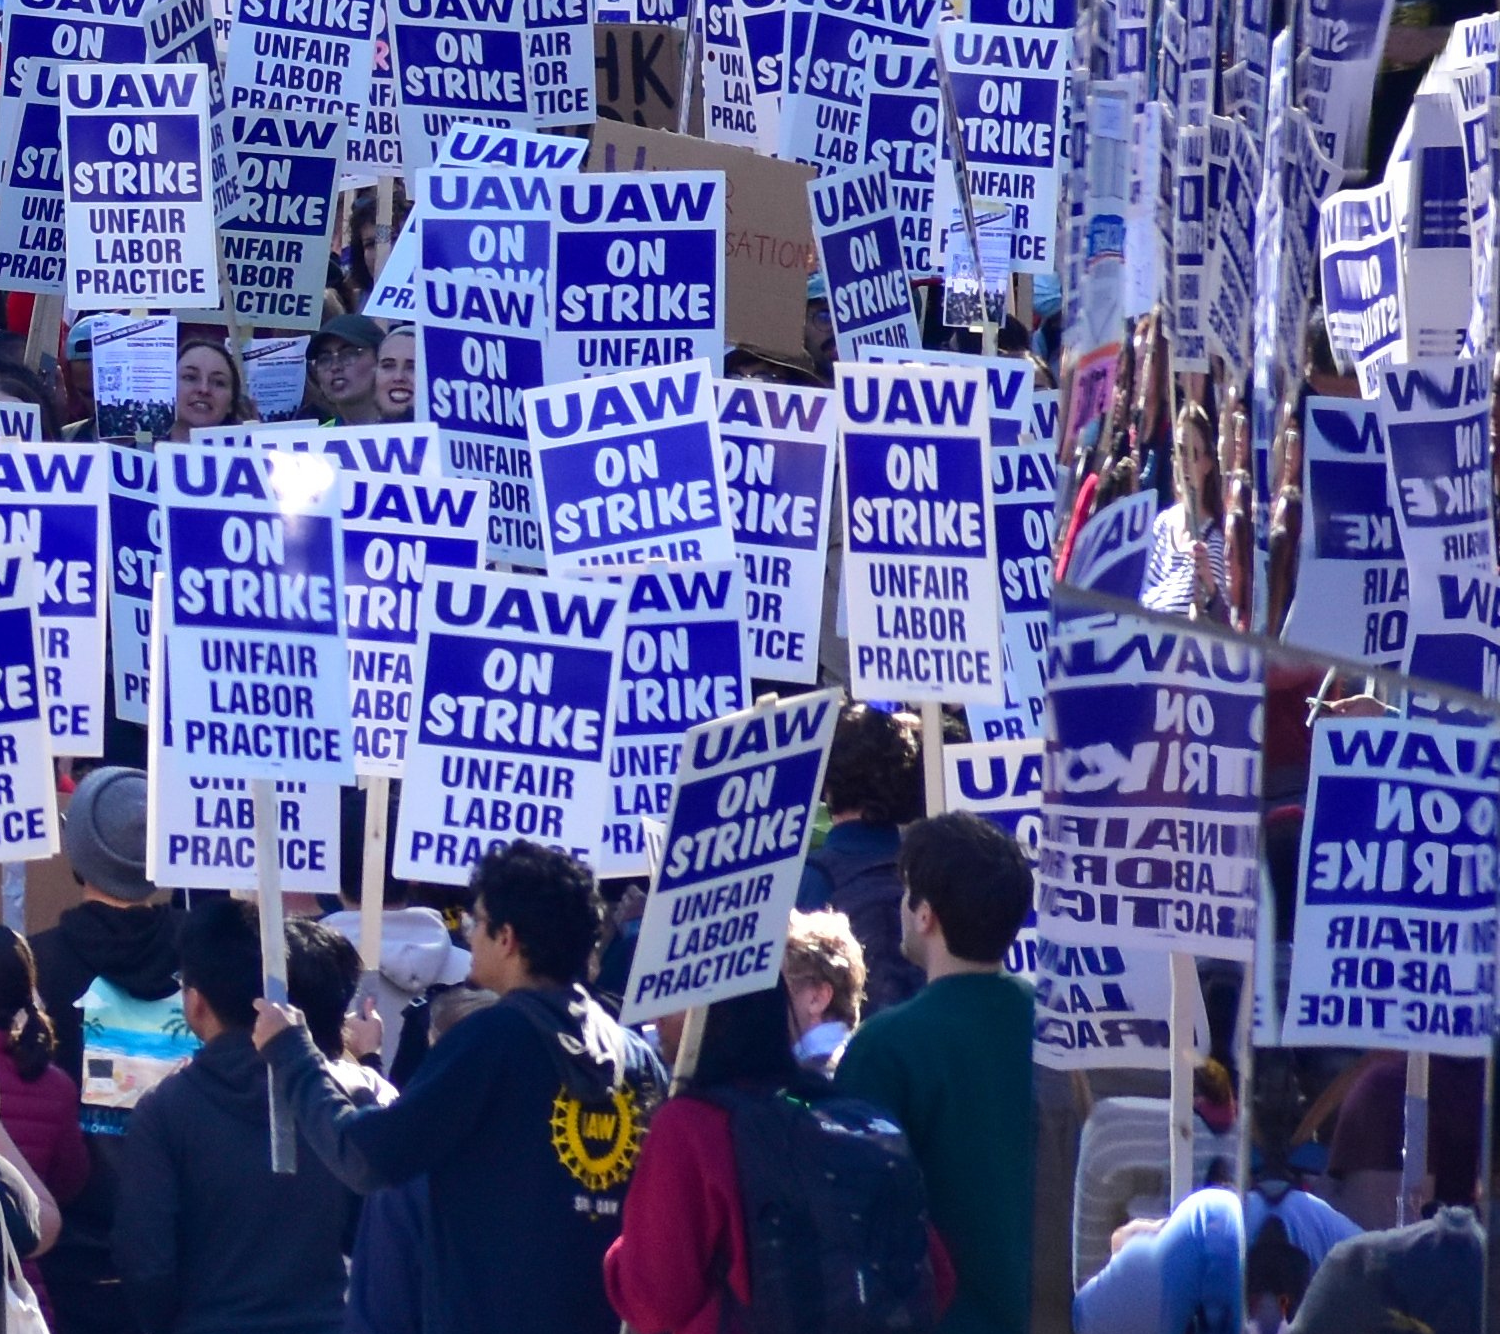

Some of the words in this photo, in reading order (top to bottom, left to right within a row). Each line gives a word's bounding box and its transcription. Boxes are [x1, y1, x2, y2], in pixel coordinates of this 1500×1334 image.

[66, 73, 197, 109] UAW
[107, 121, 158, 155] ON
[72, 160, 197, 195] STRIKE
[89, 207, 185, 234] UNFAIR
[94, 238, 181, 264] LABOR
[75, 267, 205, 294] PRACTICE
[692, 700, 829, 770] UAW
[716, 764, 776, 818] ON
[665, 803, 805, 878] STRIKE
[670, 872, 774, 927] UNFAIR
[666, 910, 759, 962] LABOR
[634, 940, 774, 1004] PRACTICE
